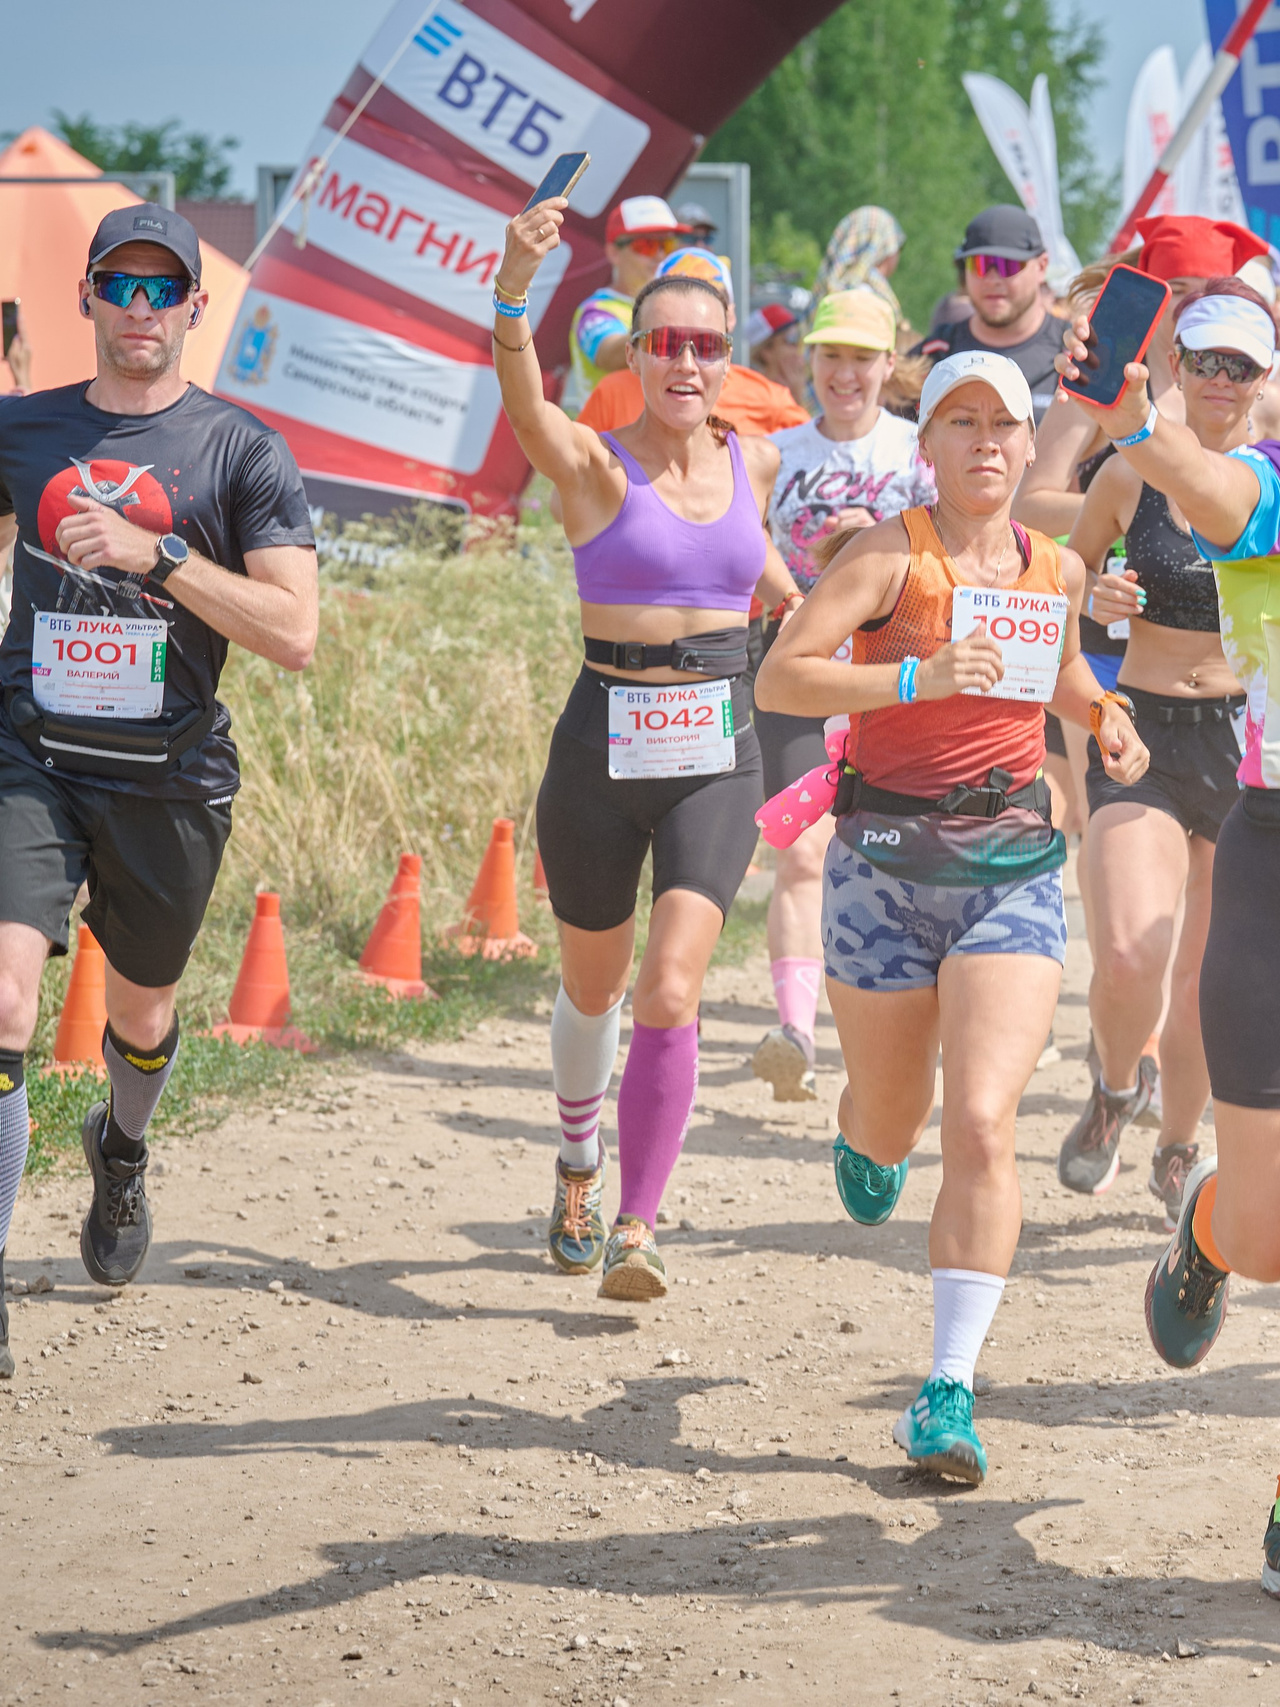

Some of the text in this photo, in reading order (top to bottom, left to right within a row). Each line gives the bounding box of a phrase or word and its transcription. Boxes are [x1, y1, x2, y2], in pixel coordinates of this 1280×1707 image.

[437, 51, 564, 158] ВТБ
[139, 219, 163, 230] FILA
[318, 171, 503, 286] магни
[289, 344, 469, 414] Министерство спорта
[282, 361, 444, 427] Самарской области
[776, 464, 898, 510] NOW
[973, 593, 1000, 608] ВТБ
[1006, 596, 1050, 613] ЛУКА
[50, 618, 159, 636] ВТБ ЛУКА УЛЬТРА
[53, 639, 137, 666] 1001
[153, 643, 163, 681] ТРЕЙЛ
[67, 669, 120, 681] ВАЛЕРИЙ
[627, 692, 651, 704] ВТБ
[656, 690, 698, 703] ЛУКА
[699, 685, 725, 694] УЛЬТРА
[628, 706, 715, 731] 1042
[723, 701, 732, 737] ТРЕЙЛ
[646, 734, 700, 745] ВИКТОРИЯ
